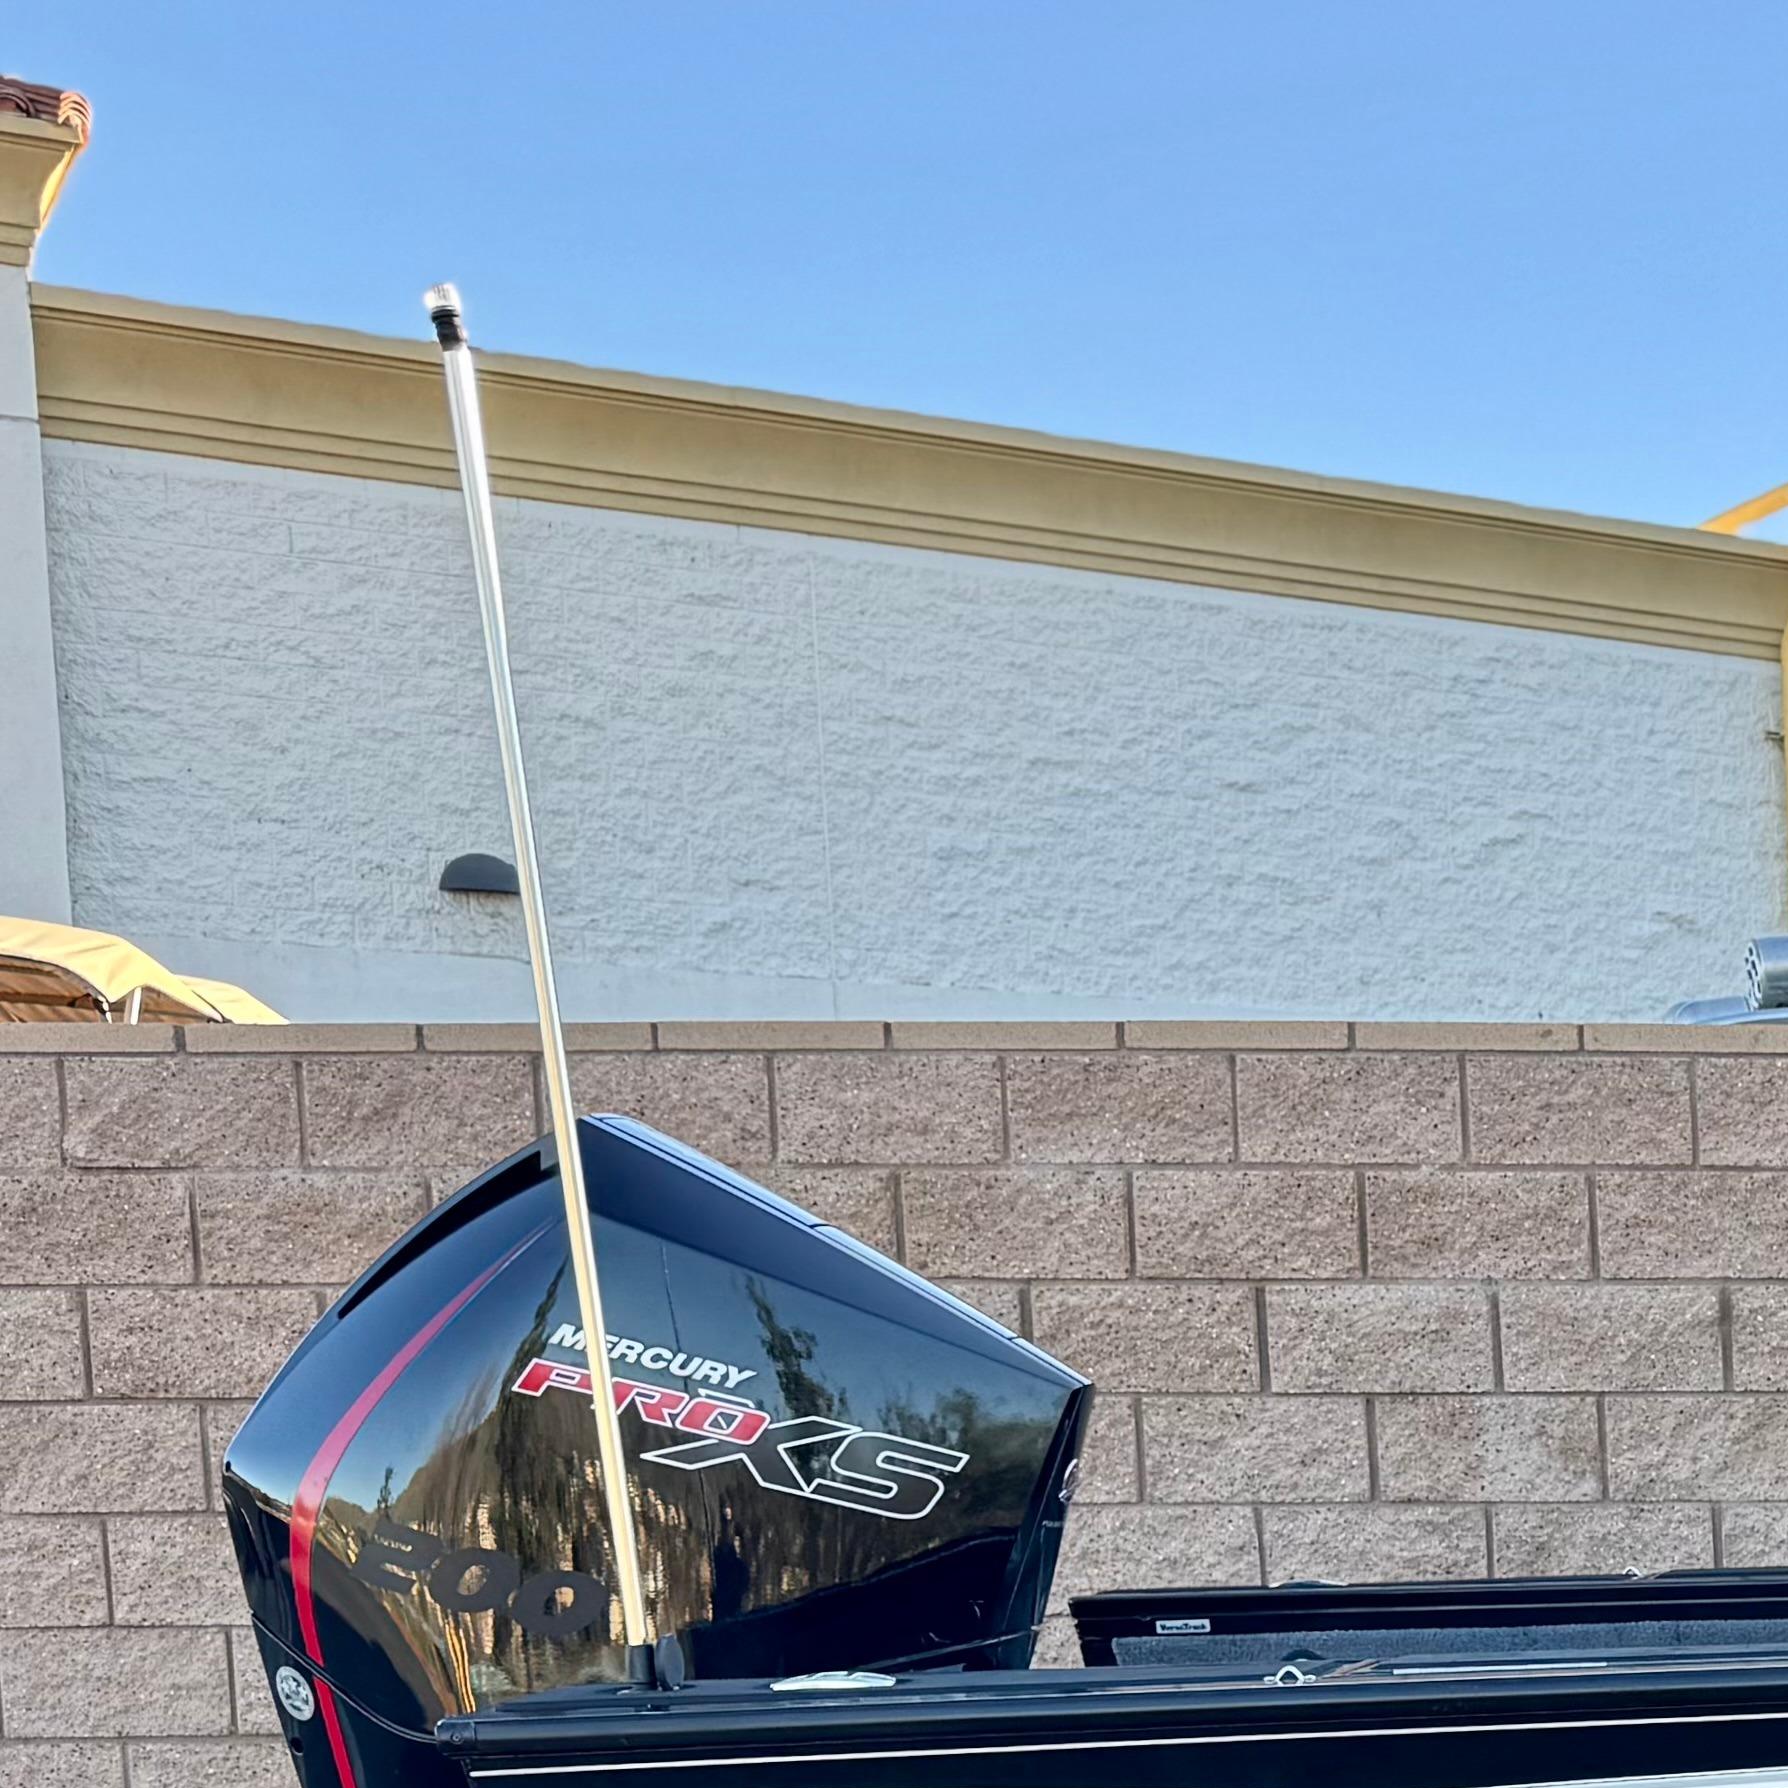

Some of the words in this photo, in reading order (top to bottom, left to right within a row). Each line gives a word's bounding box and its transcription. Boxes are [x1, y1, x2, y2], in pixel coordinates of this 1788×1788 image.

[511, 1357, 771, 1445] PRO
[640, 1387, 970, 1520] XS
[348, 1522, 608, 1636] 200
